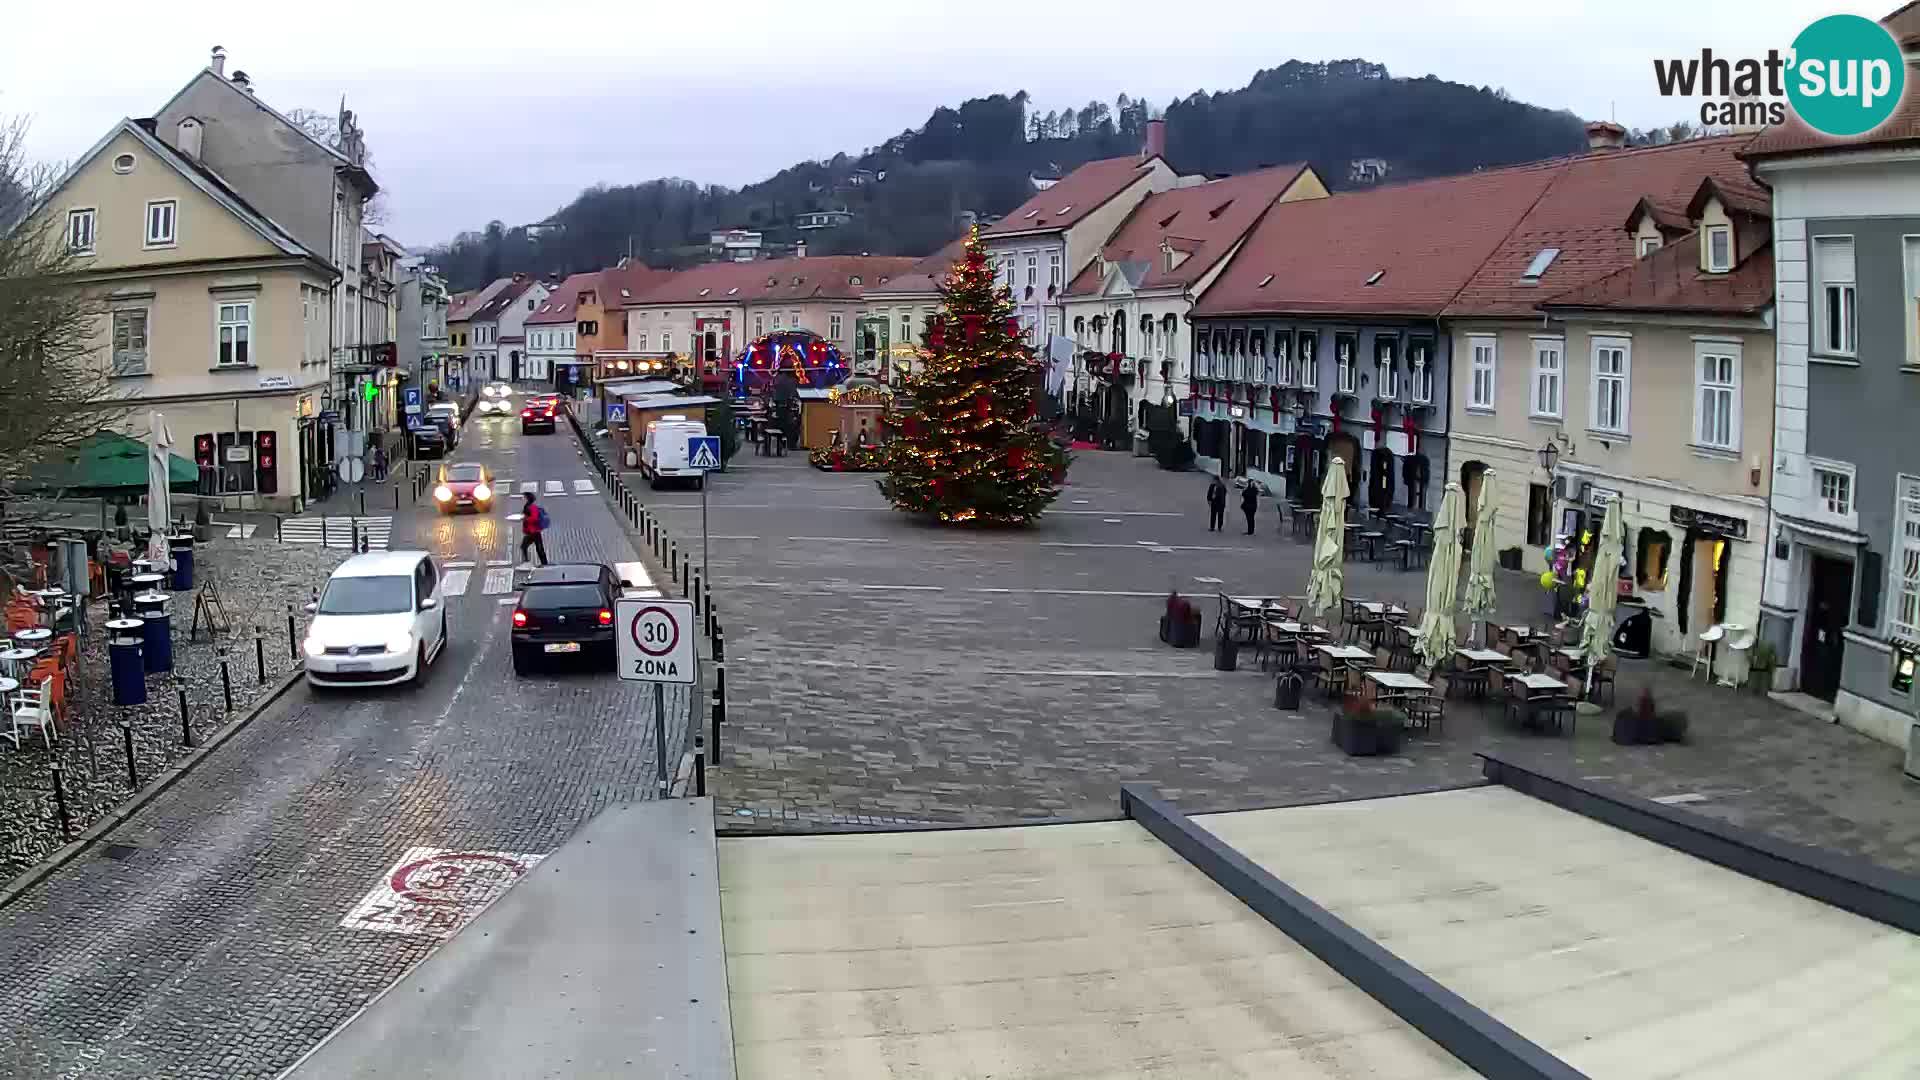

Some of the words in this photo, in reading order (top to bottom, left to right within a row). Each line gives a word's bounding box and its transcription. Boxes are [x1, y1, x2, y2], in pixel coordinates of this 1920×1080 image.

[409, 391, 417, 402] P
[644, 622, 667, 643] 30
[634, 659, 678, 676] ZONA
